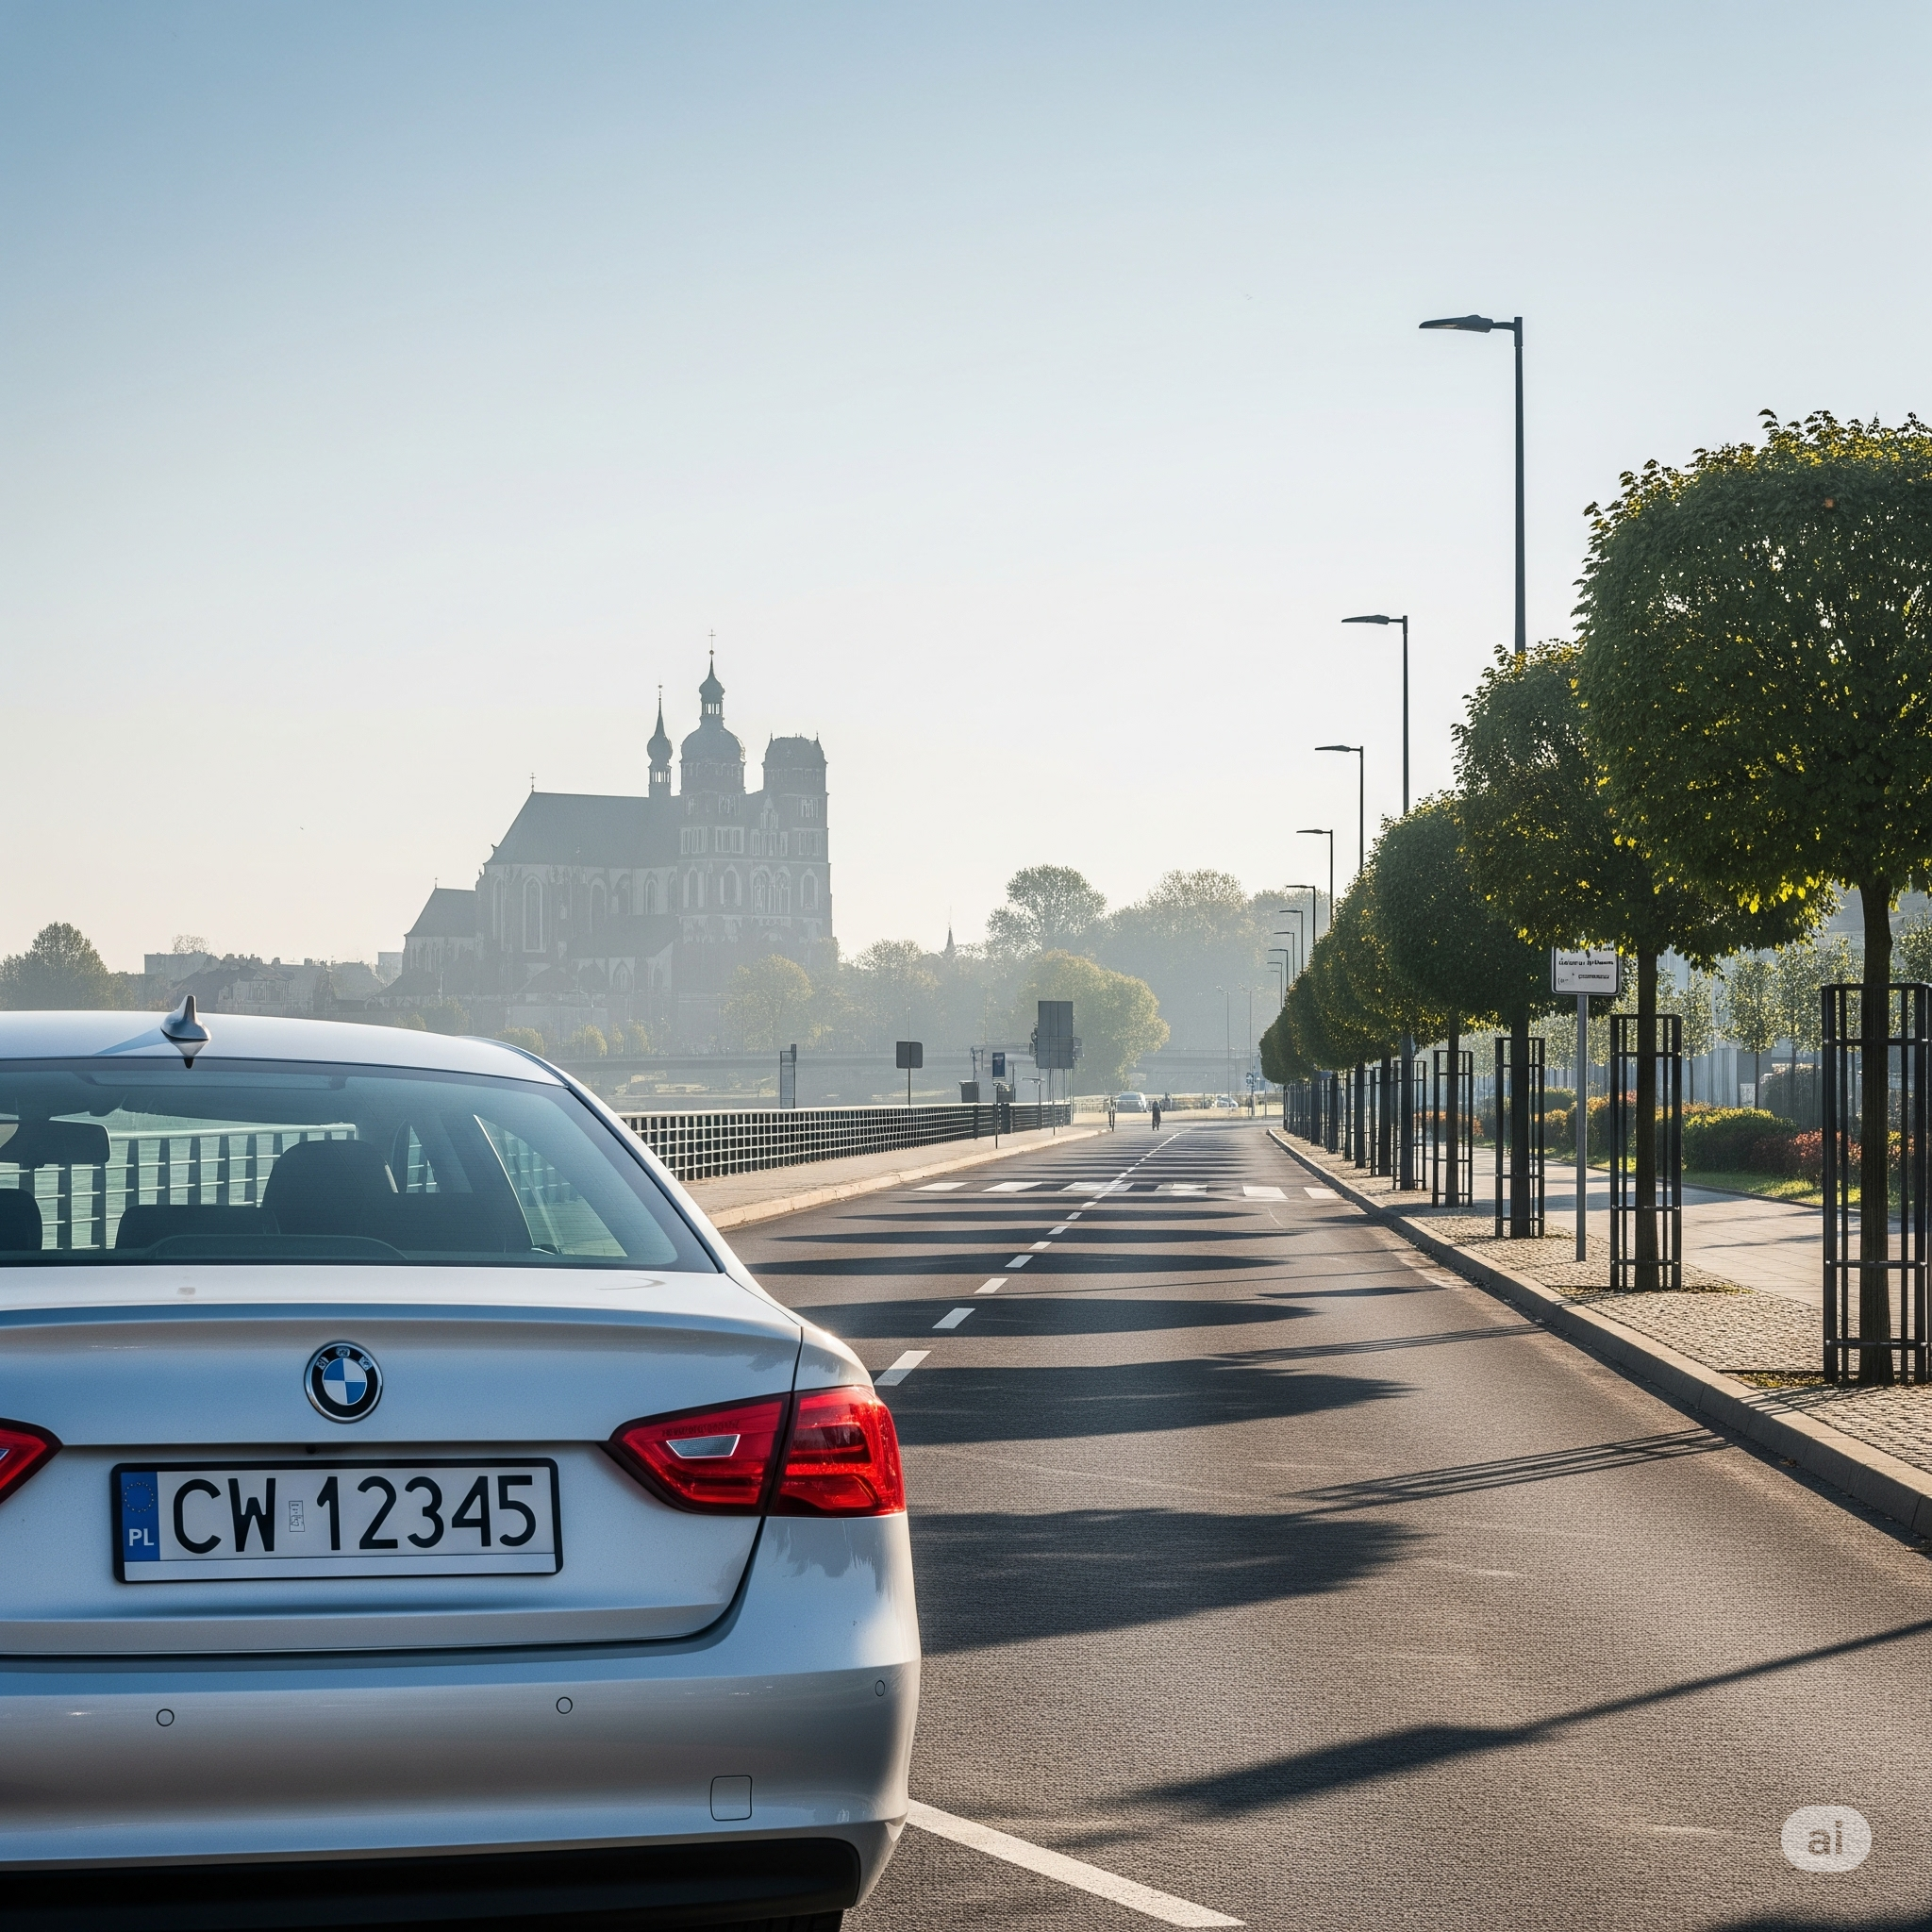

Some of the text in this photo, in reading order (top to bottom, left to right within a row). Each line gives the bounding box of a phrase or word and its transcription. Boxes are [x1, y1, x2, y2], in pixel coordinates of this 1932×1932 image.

[128, 1528, 155, 1547] PL
[173, 1474, 537, 1554] CW 12345
